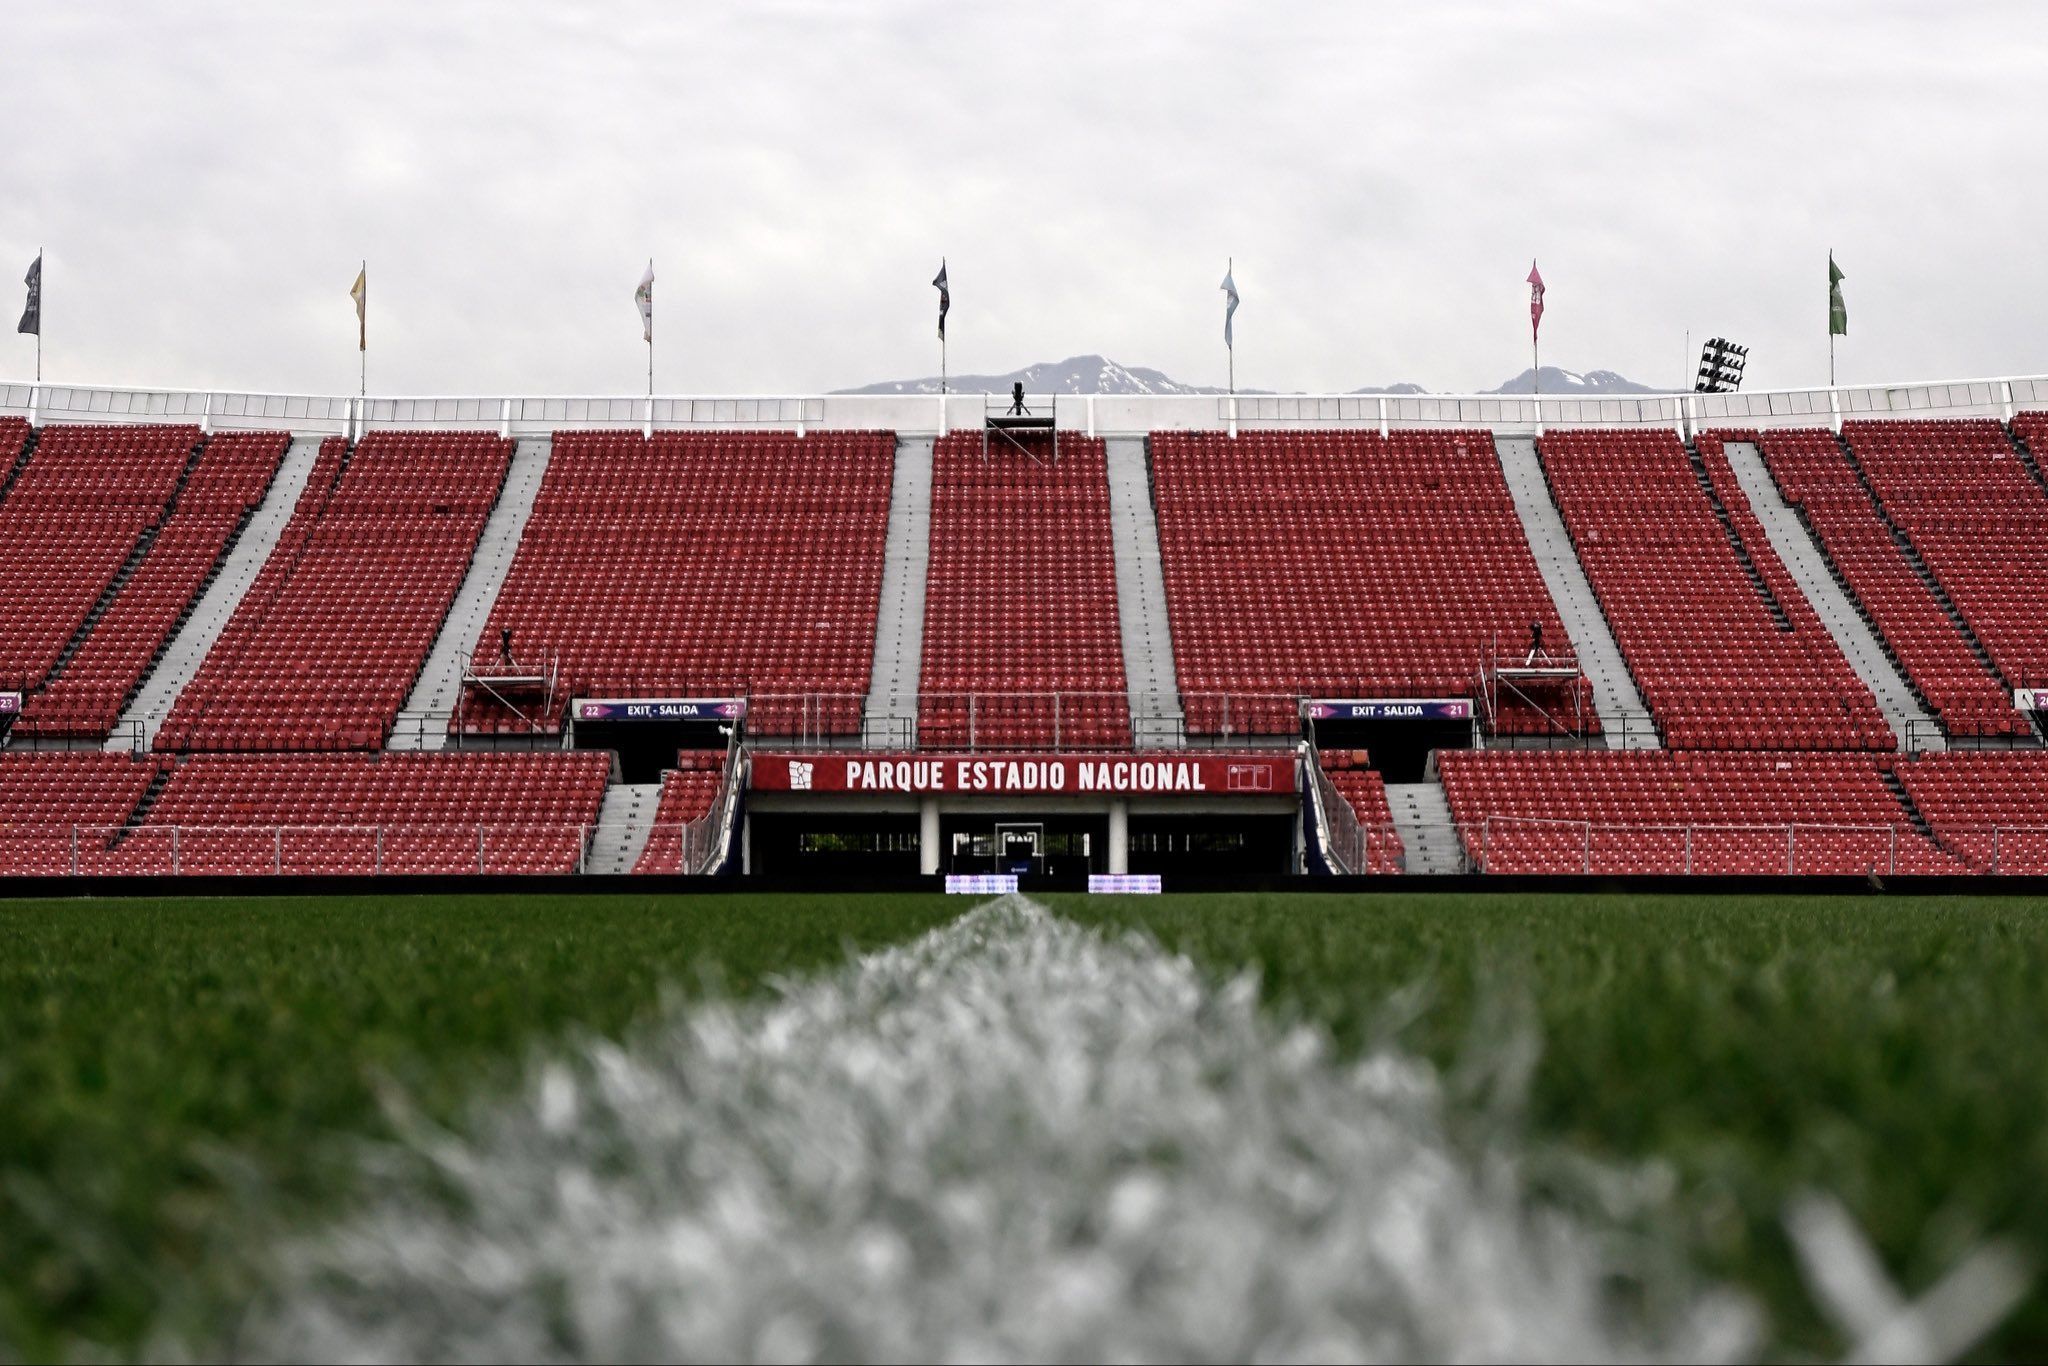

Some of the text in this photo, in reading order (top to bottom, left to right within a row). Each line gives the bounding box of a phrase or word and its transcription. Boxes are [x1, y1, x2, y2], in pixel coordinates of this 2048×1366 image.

[2040, 697, 2048, 706] 2
[586, 706, 599, 716] 22
[627, 705, 650, 715] EXIT
[659, 705, 698, 715] SALIDA
[725, 704, 738, 714] 22
[1310, 706, 1322, 716] 21
[1351, 706, 1376, 716] EXIT
[1384, 705, 1423, 715] SALIDA
[1450, 705, 1462, 715] 21
[846, 760, 1206, 791] PARQUE ESTADIO NACIONAL
